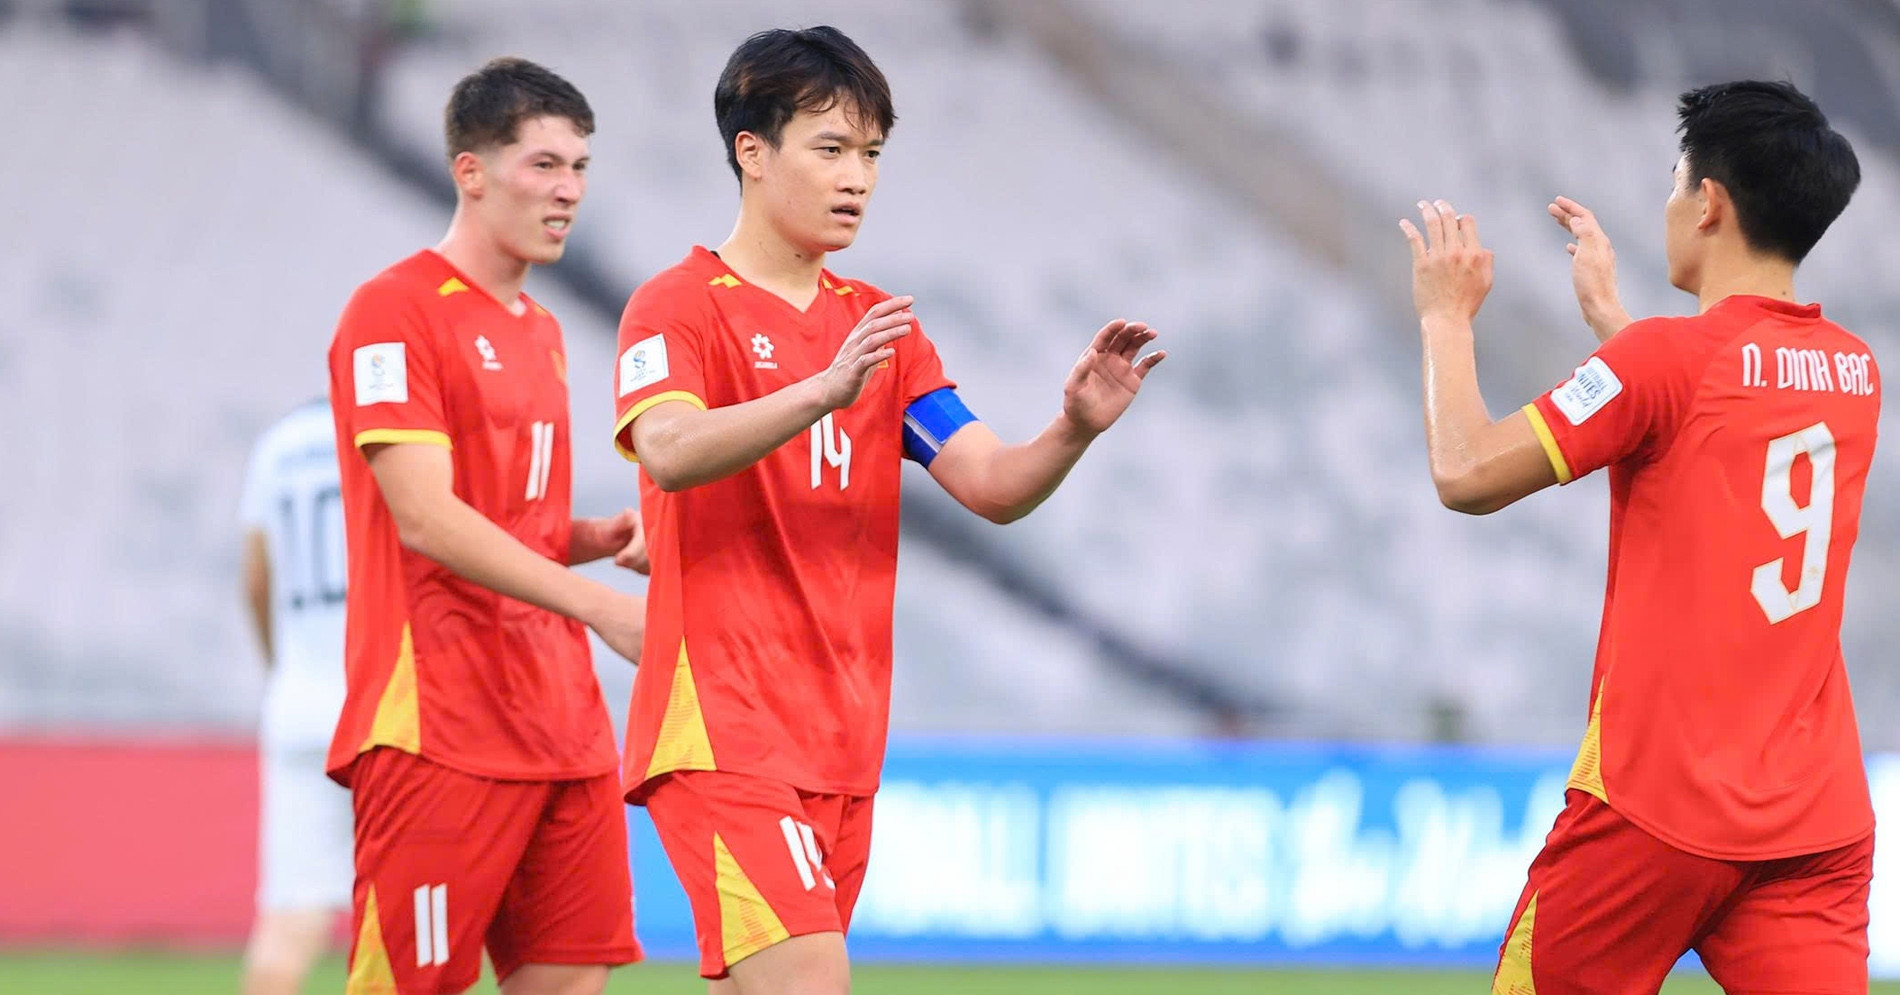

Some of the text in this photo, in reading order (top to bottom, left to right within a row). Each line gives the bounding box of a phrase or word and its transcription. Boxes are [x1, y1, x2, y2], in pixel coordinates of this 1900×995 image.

[1775, 347, 1834, 392] DINH
[1833, 351, 1874, 396] BAC
[525, 420, 554, 501] 11
[810, 411, 852, 491] 14
[1750, 421, 1837, 625] 9
[414, 883, 449, 968] 11
